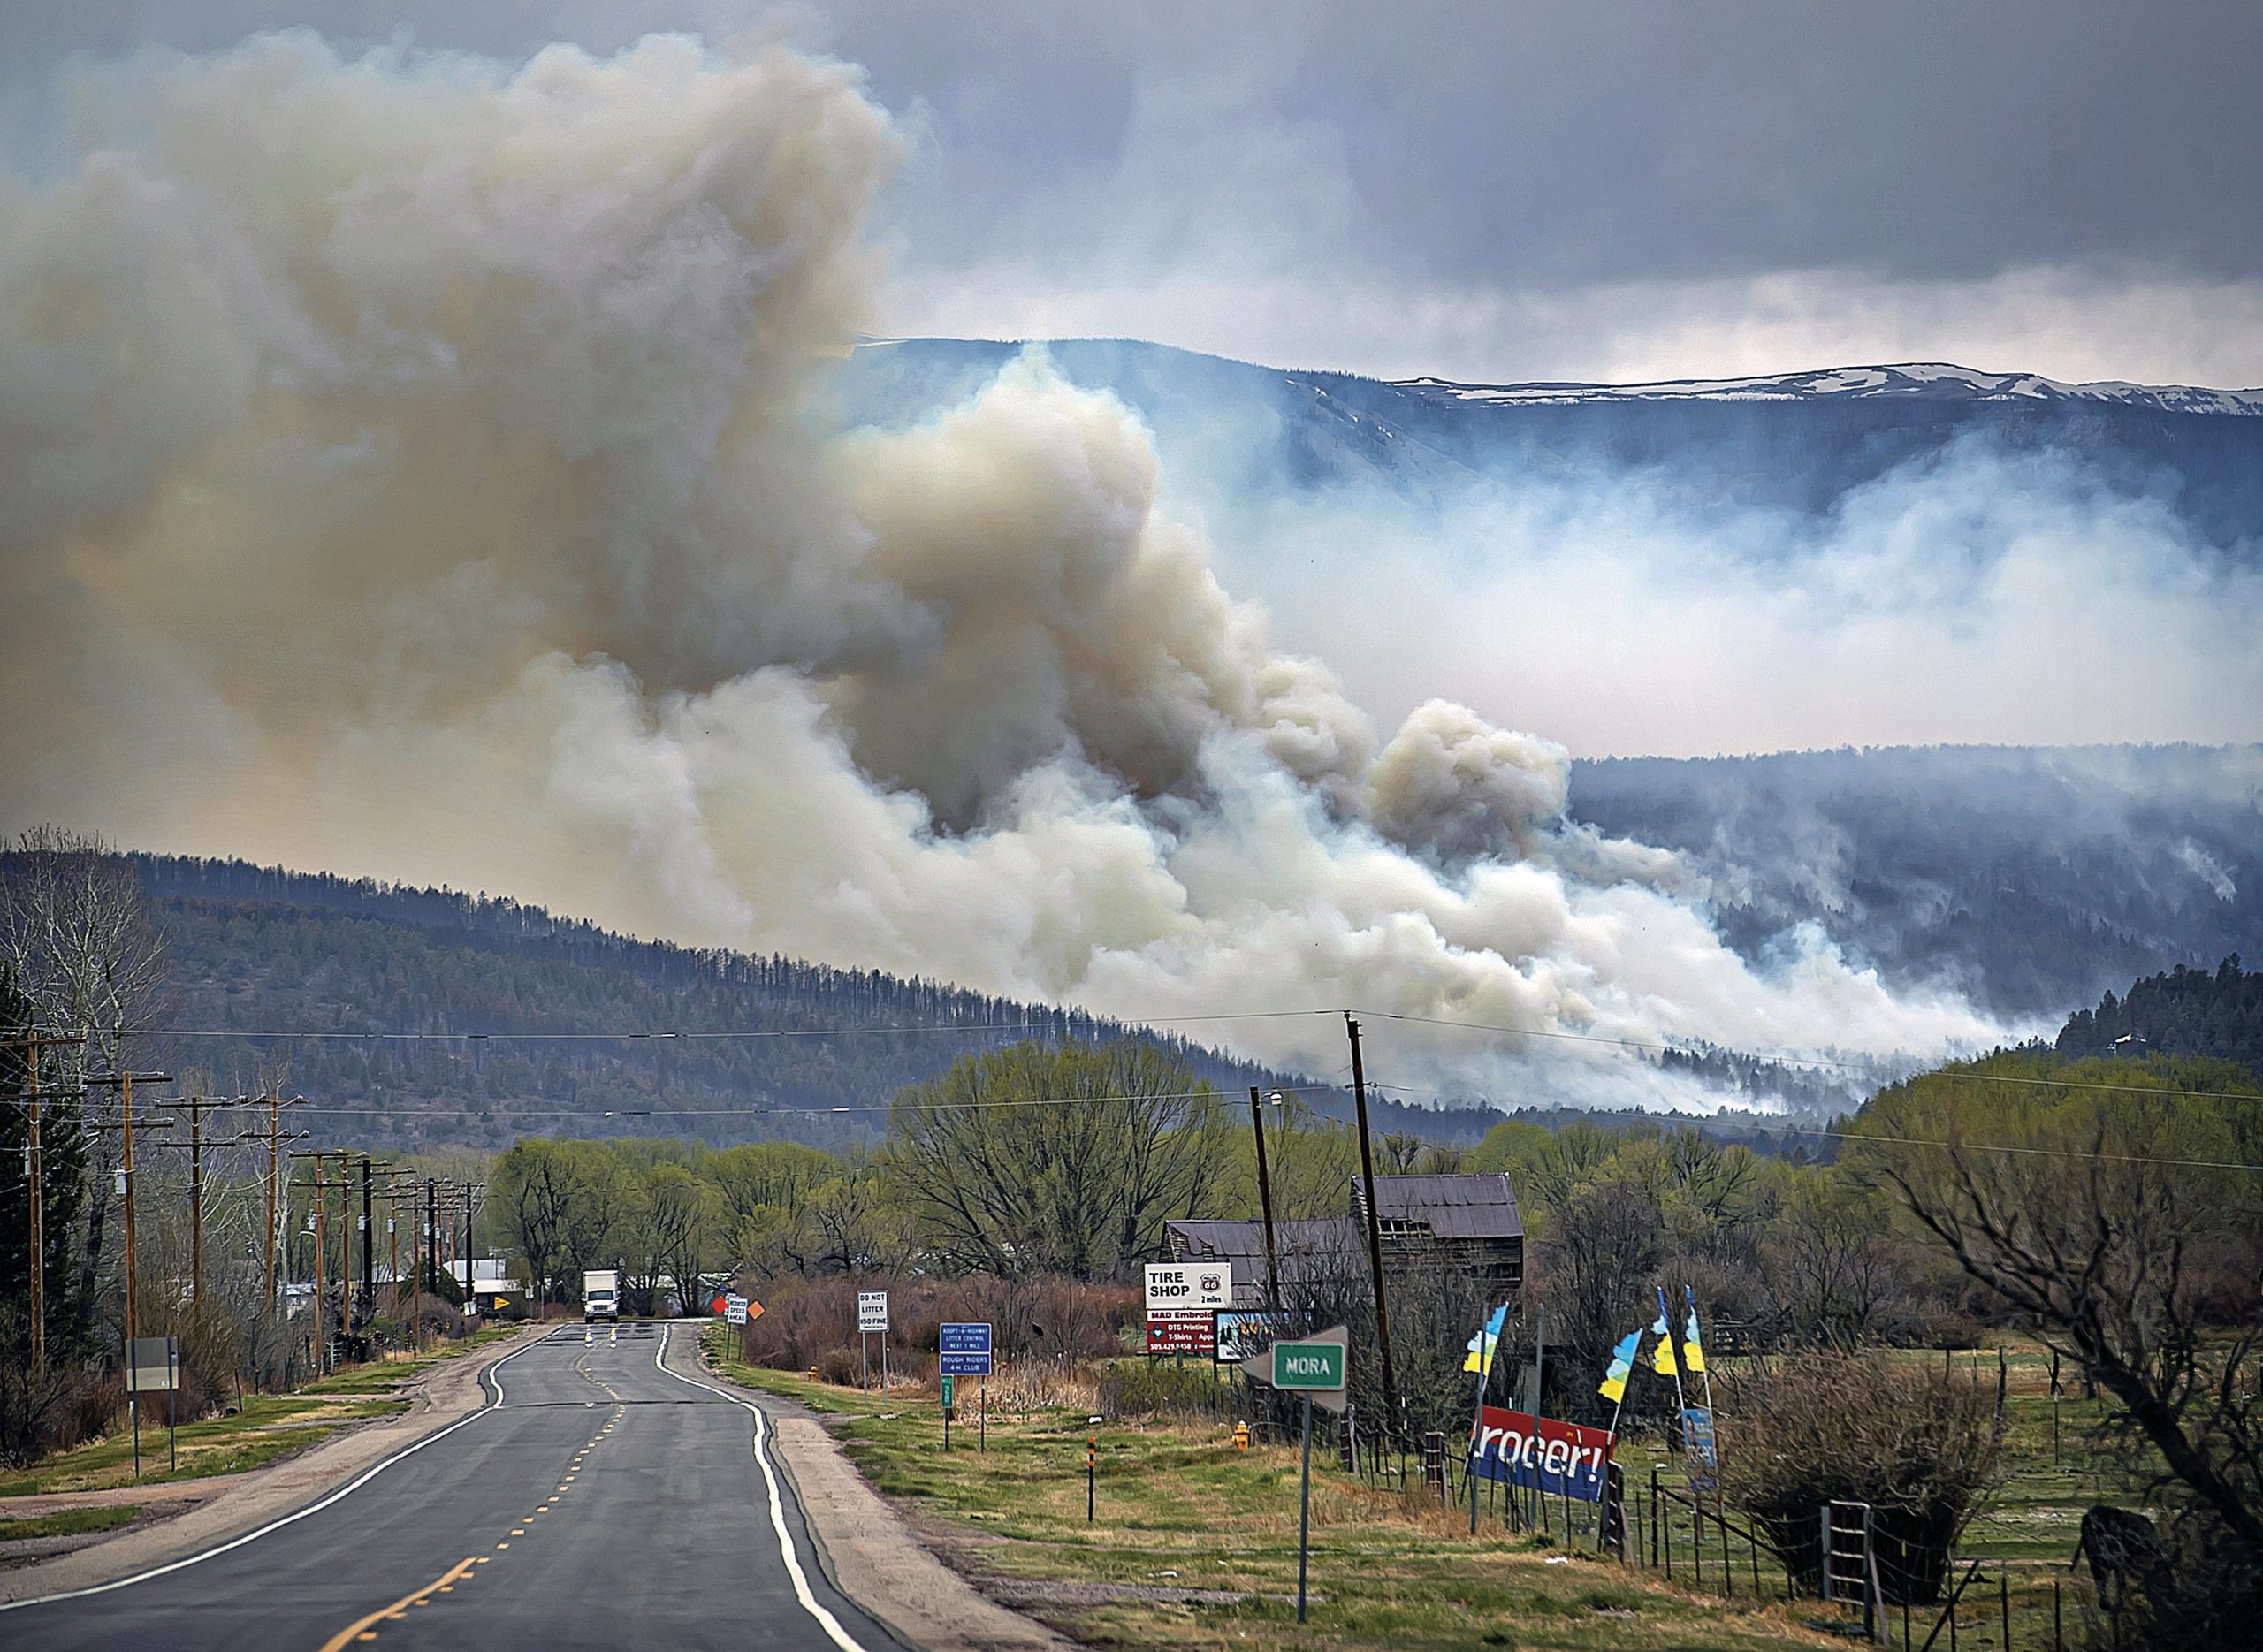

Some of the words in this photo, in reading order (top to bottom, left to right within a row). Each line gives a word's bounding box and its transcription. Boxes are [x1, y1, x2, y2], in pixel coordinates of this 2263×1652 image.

[1148, 1272, 1184, 1283] TIRE
[1149, 1285, 1190, 1297] SHOP
[1183, 1323, 1208, 1332] Printing
[1285, 1356, 1330, 1375] MORA
